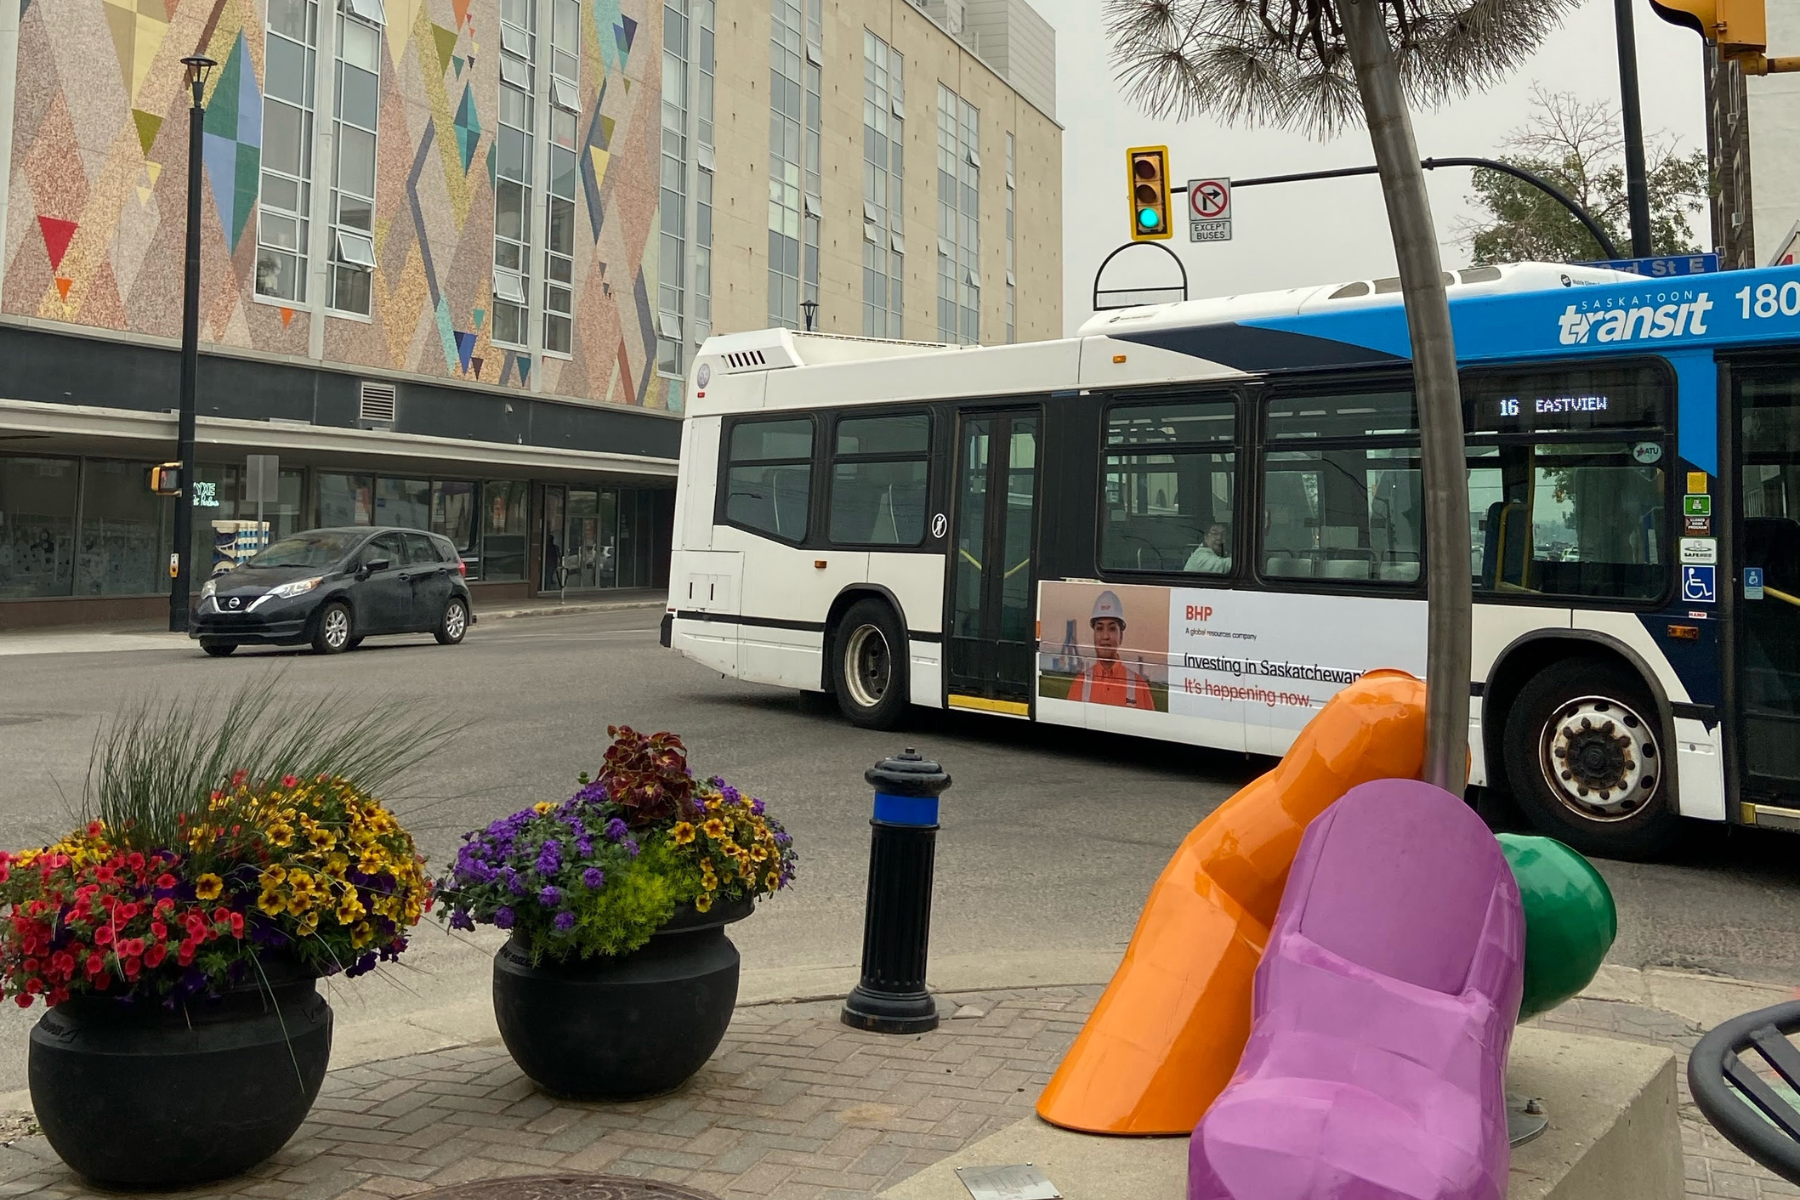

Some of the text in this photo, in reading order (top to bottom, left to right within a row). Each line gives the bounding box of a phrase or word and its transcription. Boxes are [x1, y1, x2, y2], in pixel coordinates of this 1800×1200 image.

[1194, 223, 1226, 231] EXCEPT
[1196, 231, 1225, 240] BUSES
[1651, 260, 1676, 276] St
[1689, 258, 1705, 273] E
[1581, 290, 1693, 310] SASKATOON
[1557, 292, 1714, 345] transit
[1500, 396, 1608, 416] 16 EASTVIEW
[1645, 447, 1659, 455] ATU
[1185, 605, 1213, 621] BHP
[1190, 628, 1206, 637] global
[1206, 630, 1231, 638] resources
[1232, 632, 1257, 641] company
[1184, 652, 1242, 677] Investing
[1245, 658, 1257, 674] in
[1184, 677, 1313, 708] It's happening now.
